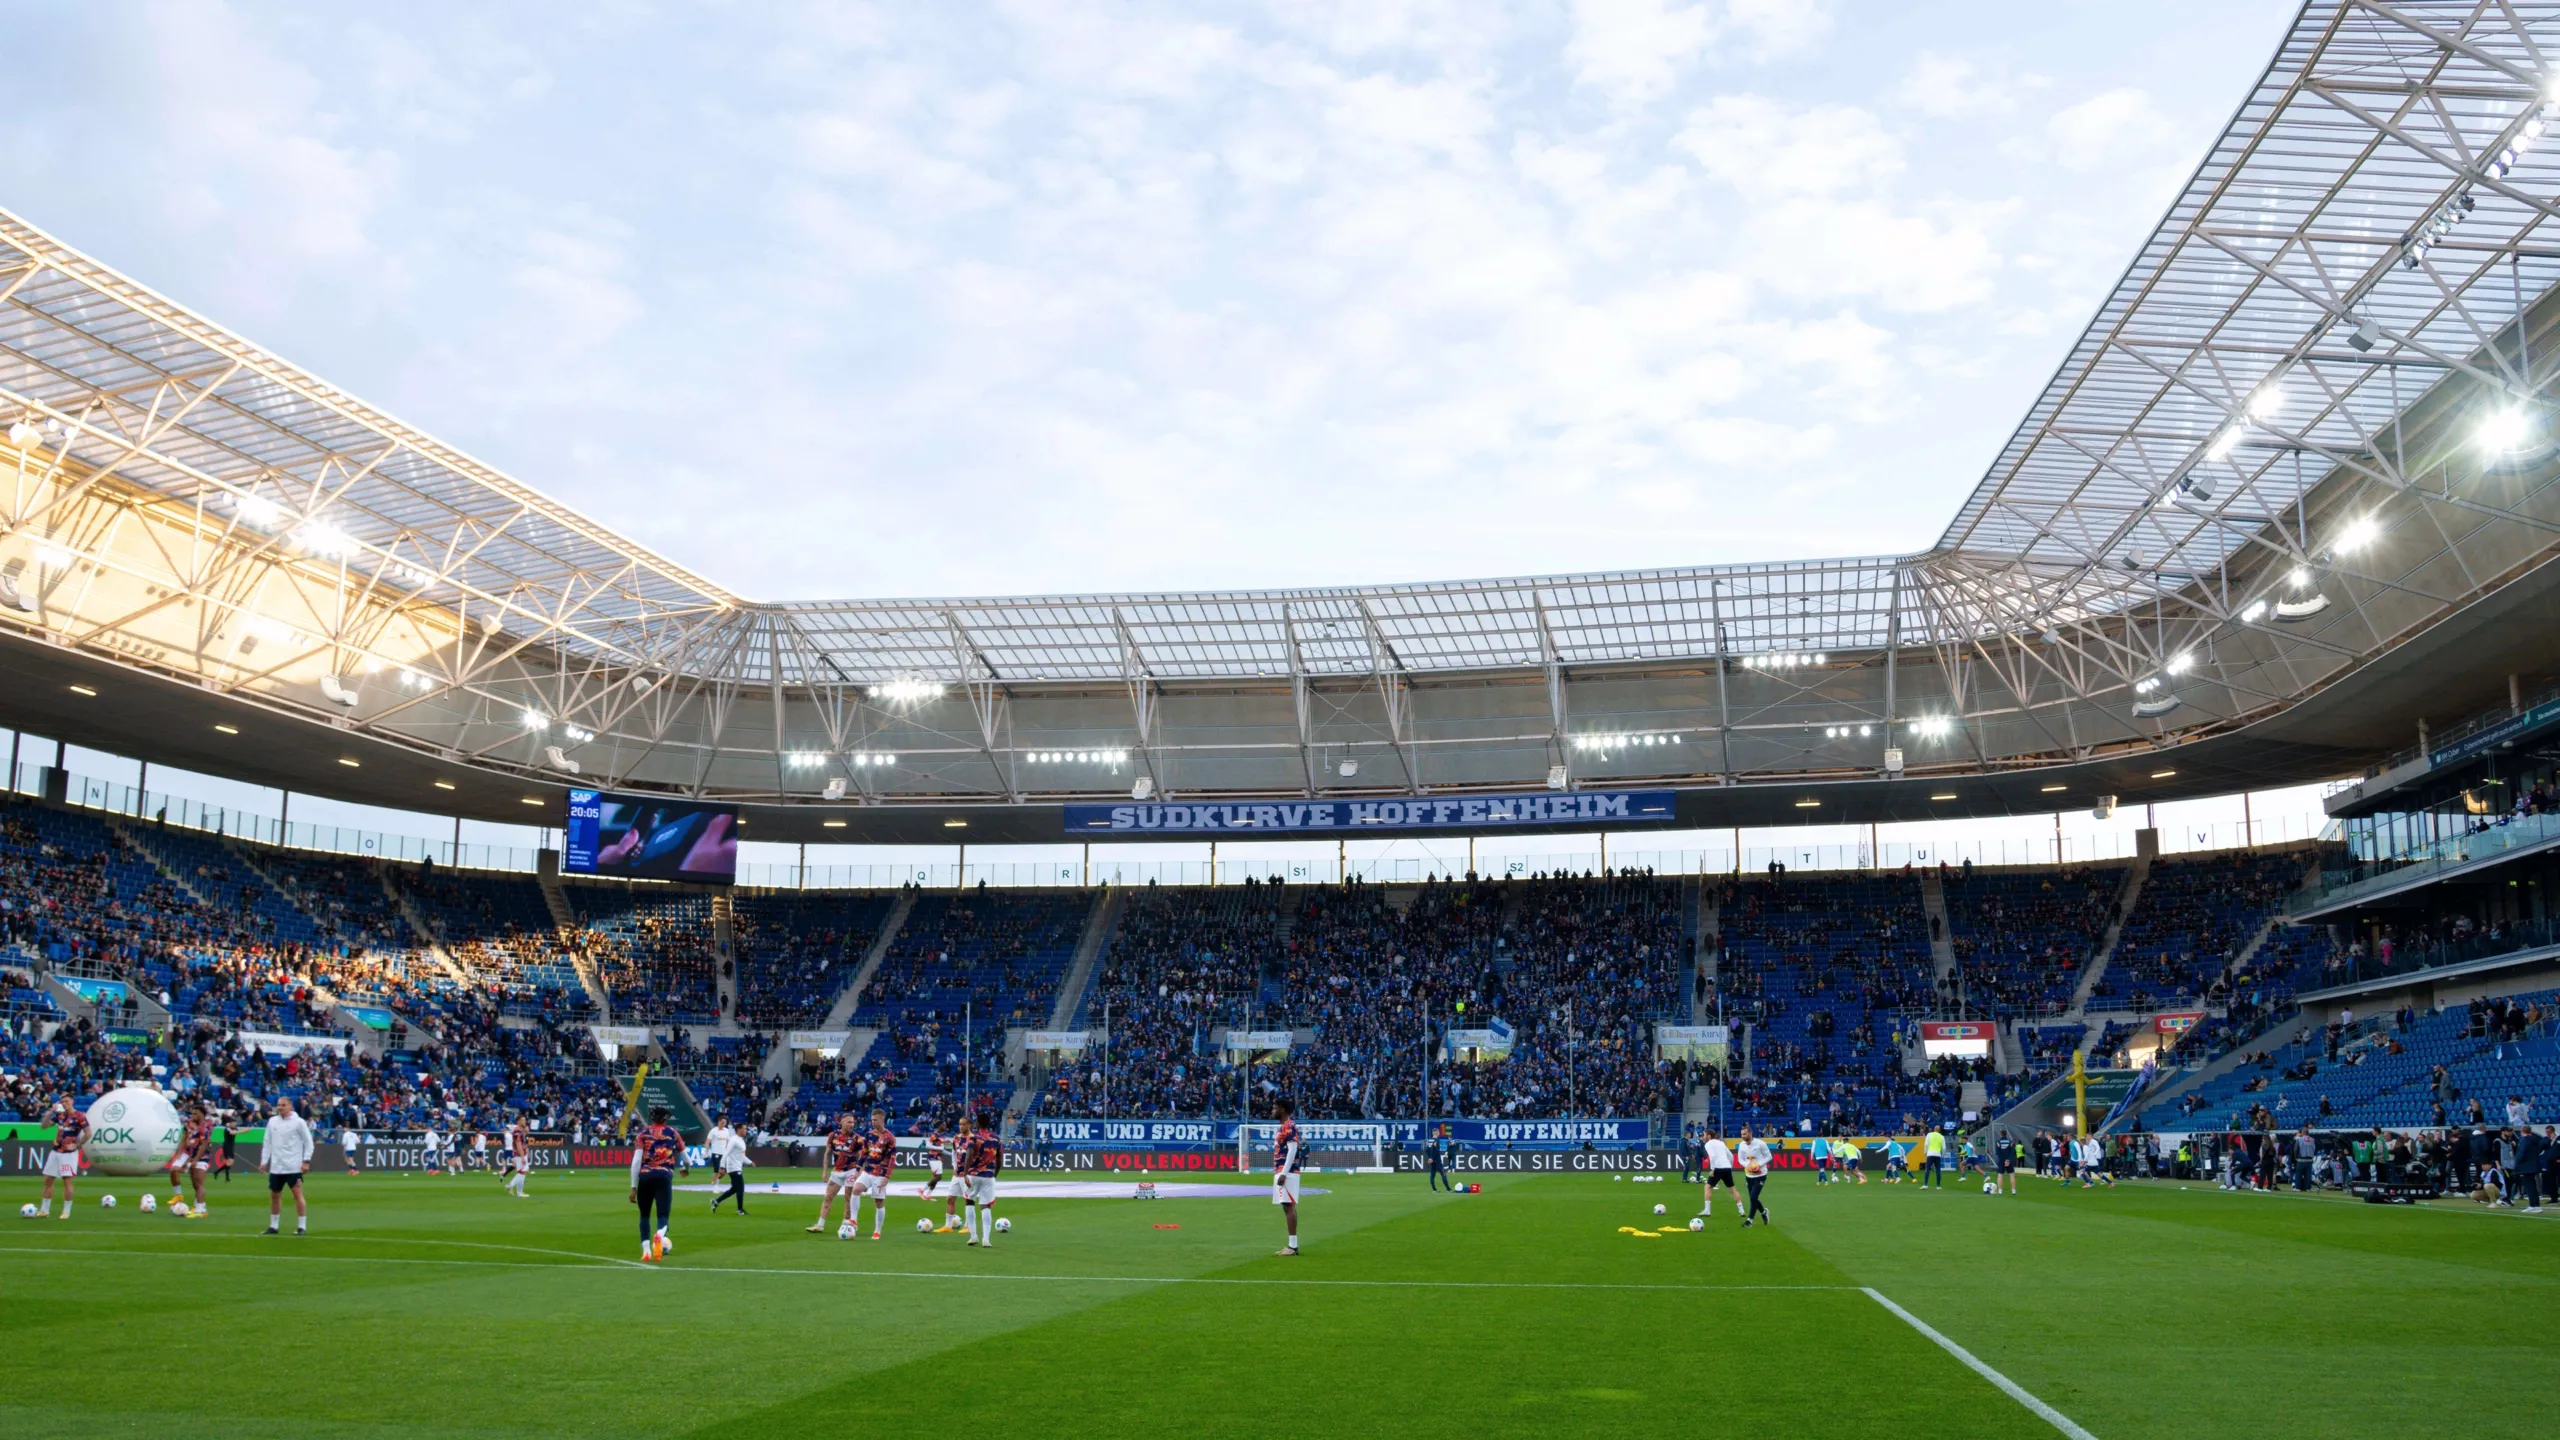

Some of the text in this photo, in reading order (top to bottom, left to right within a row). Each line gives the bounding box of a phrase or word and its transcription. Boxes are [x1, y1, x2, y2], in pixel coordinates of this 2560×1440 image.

[91, 787, 100, 799] N
[570, 792, 592, 803] SAP
[570, 806, 599, 818] 20:05
[1111, 795, 1629, 828] SÜDKURVE HOFFENHEIM
[2197, 832, 2206, 843] V
[1803, 853, 1811, 864] T
[1917, 850, 1926, 860] U
[1293, 867, 1306, 876] S1
[1510, 862, 1524, 872] S2
[917, 871, 926, 880] Q
[1062, 869, 1070, 879] R
[90, 1127, 136, 1144] AOK
[160, 1128, 182, 1144] AO
[1036, 1122, 1212, 1141] TURN- UND SPORT
[1484, 1123, 1620, 1140] HOFFENHEIM
[366, 1148, 448, 1168] ENTDECKE
[555, 1149, 569, 1167] IN
[1074, 1153, 1094, 1169] IN
[1102, 1153, 1249, 1170] VOLLENDUNG
[1532, 1153, 1563, 1170] SIE
[1572, 1153, 1657, 1170] GENUSS
